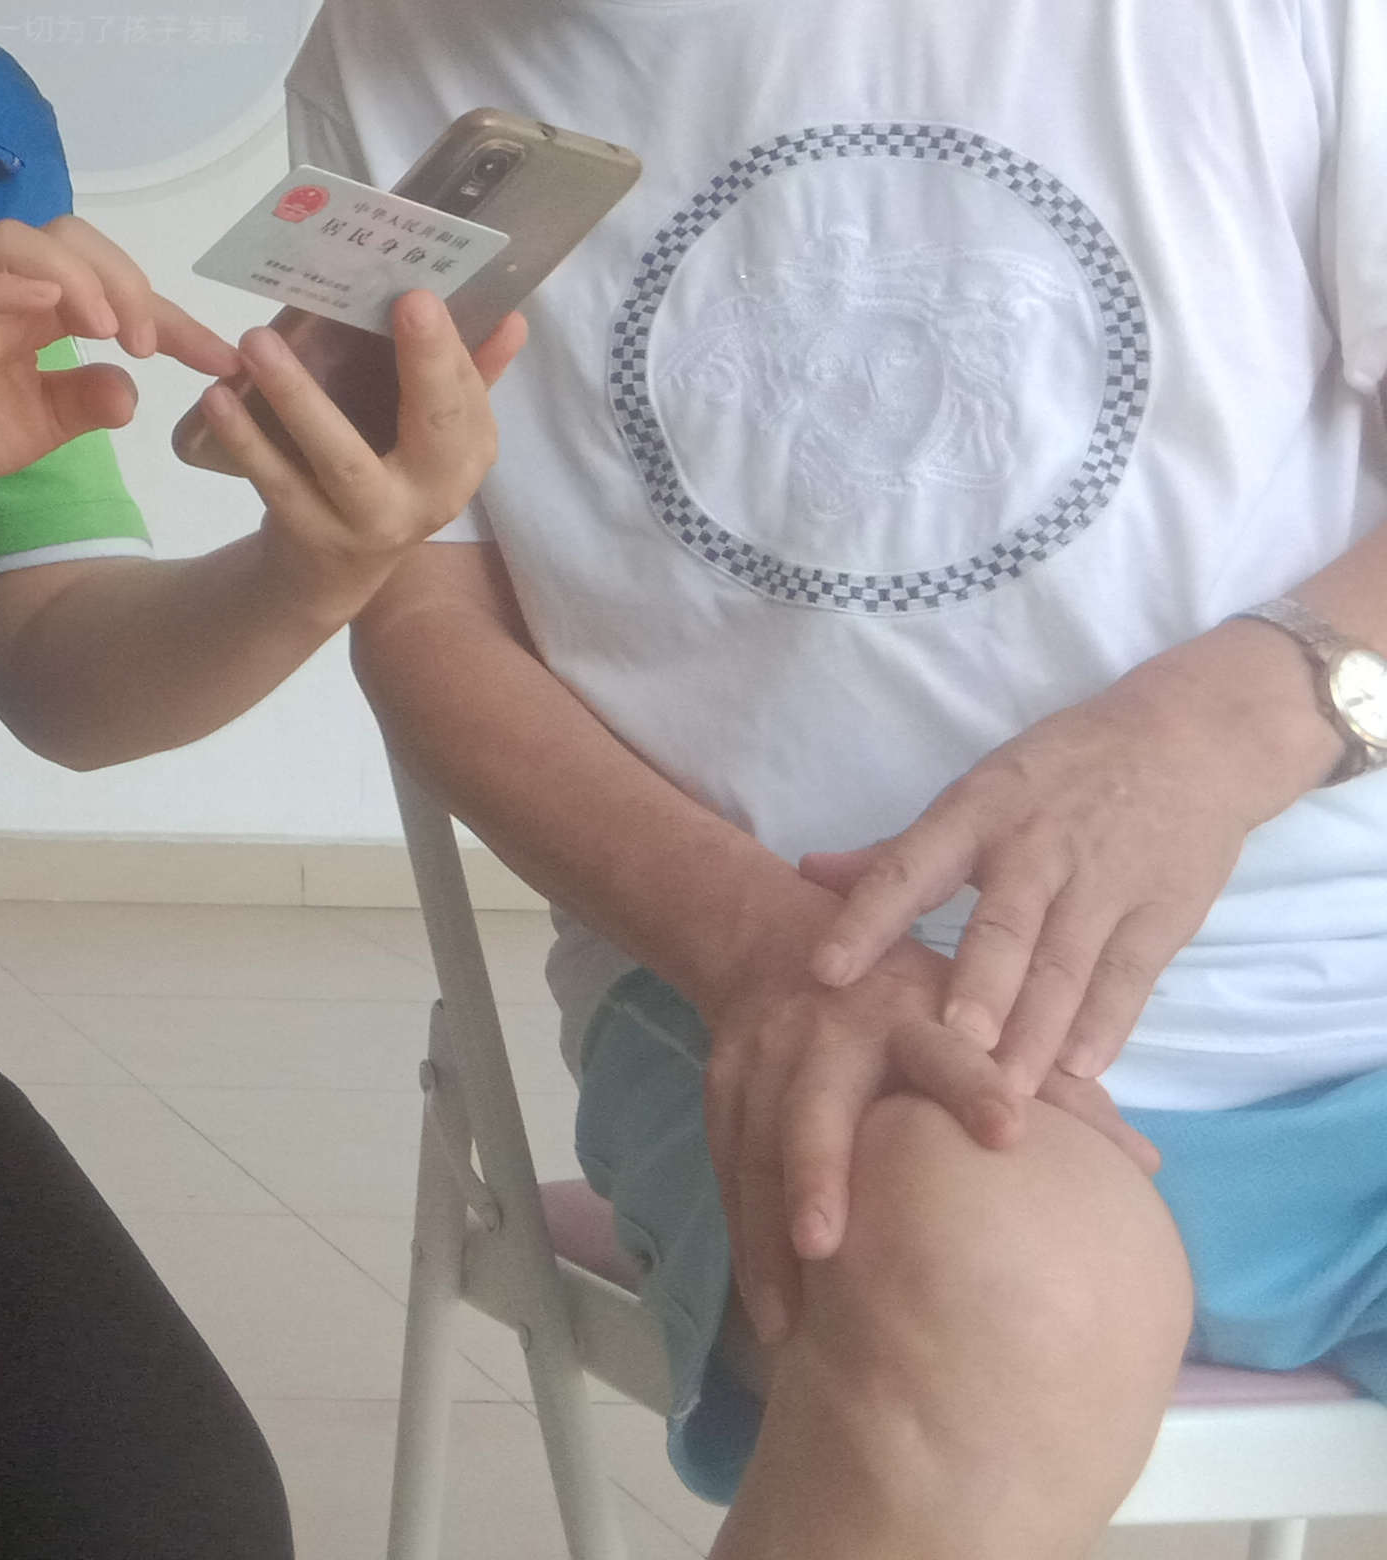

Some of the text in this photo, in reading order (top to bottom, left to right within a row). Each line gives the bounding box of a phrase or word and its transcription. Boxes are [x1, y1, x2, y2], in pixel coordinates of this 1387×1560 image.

[320, 218, 460, 274] 居民身份证
